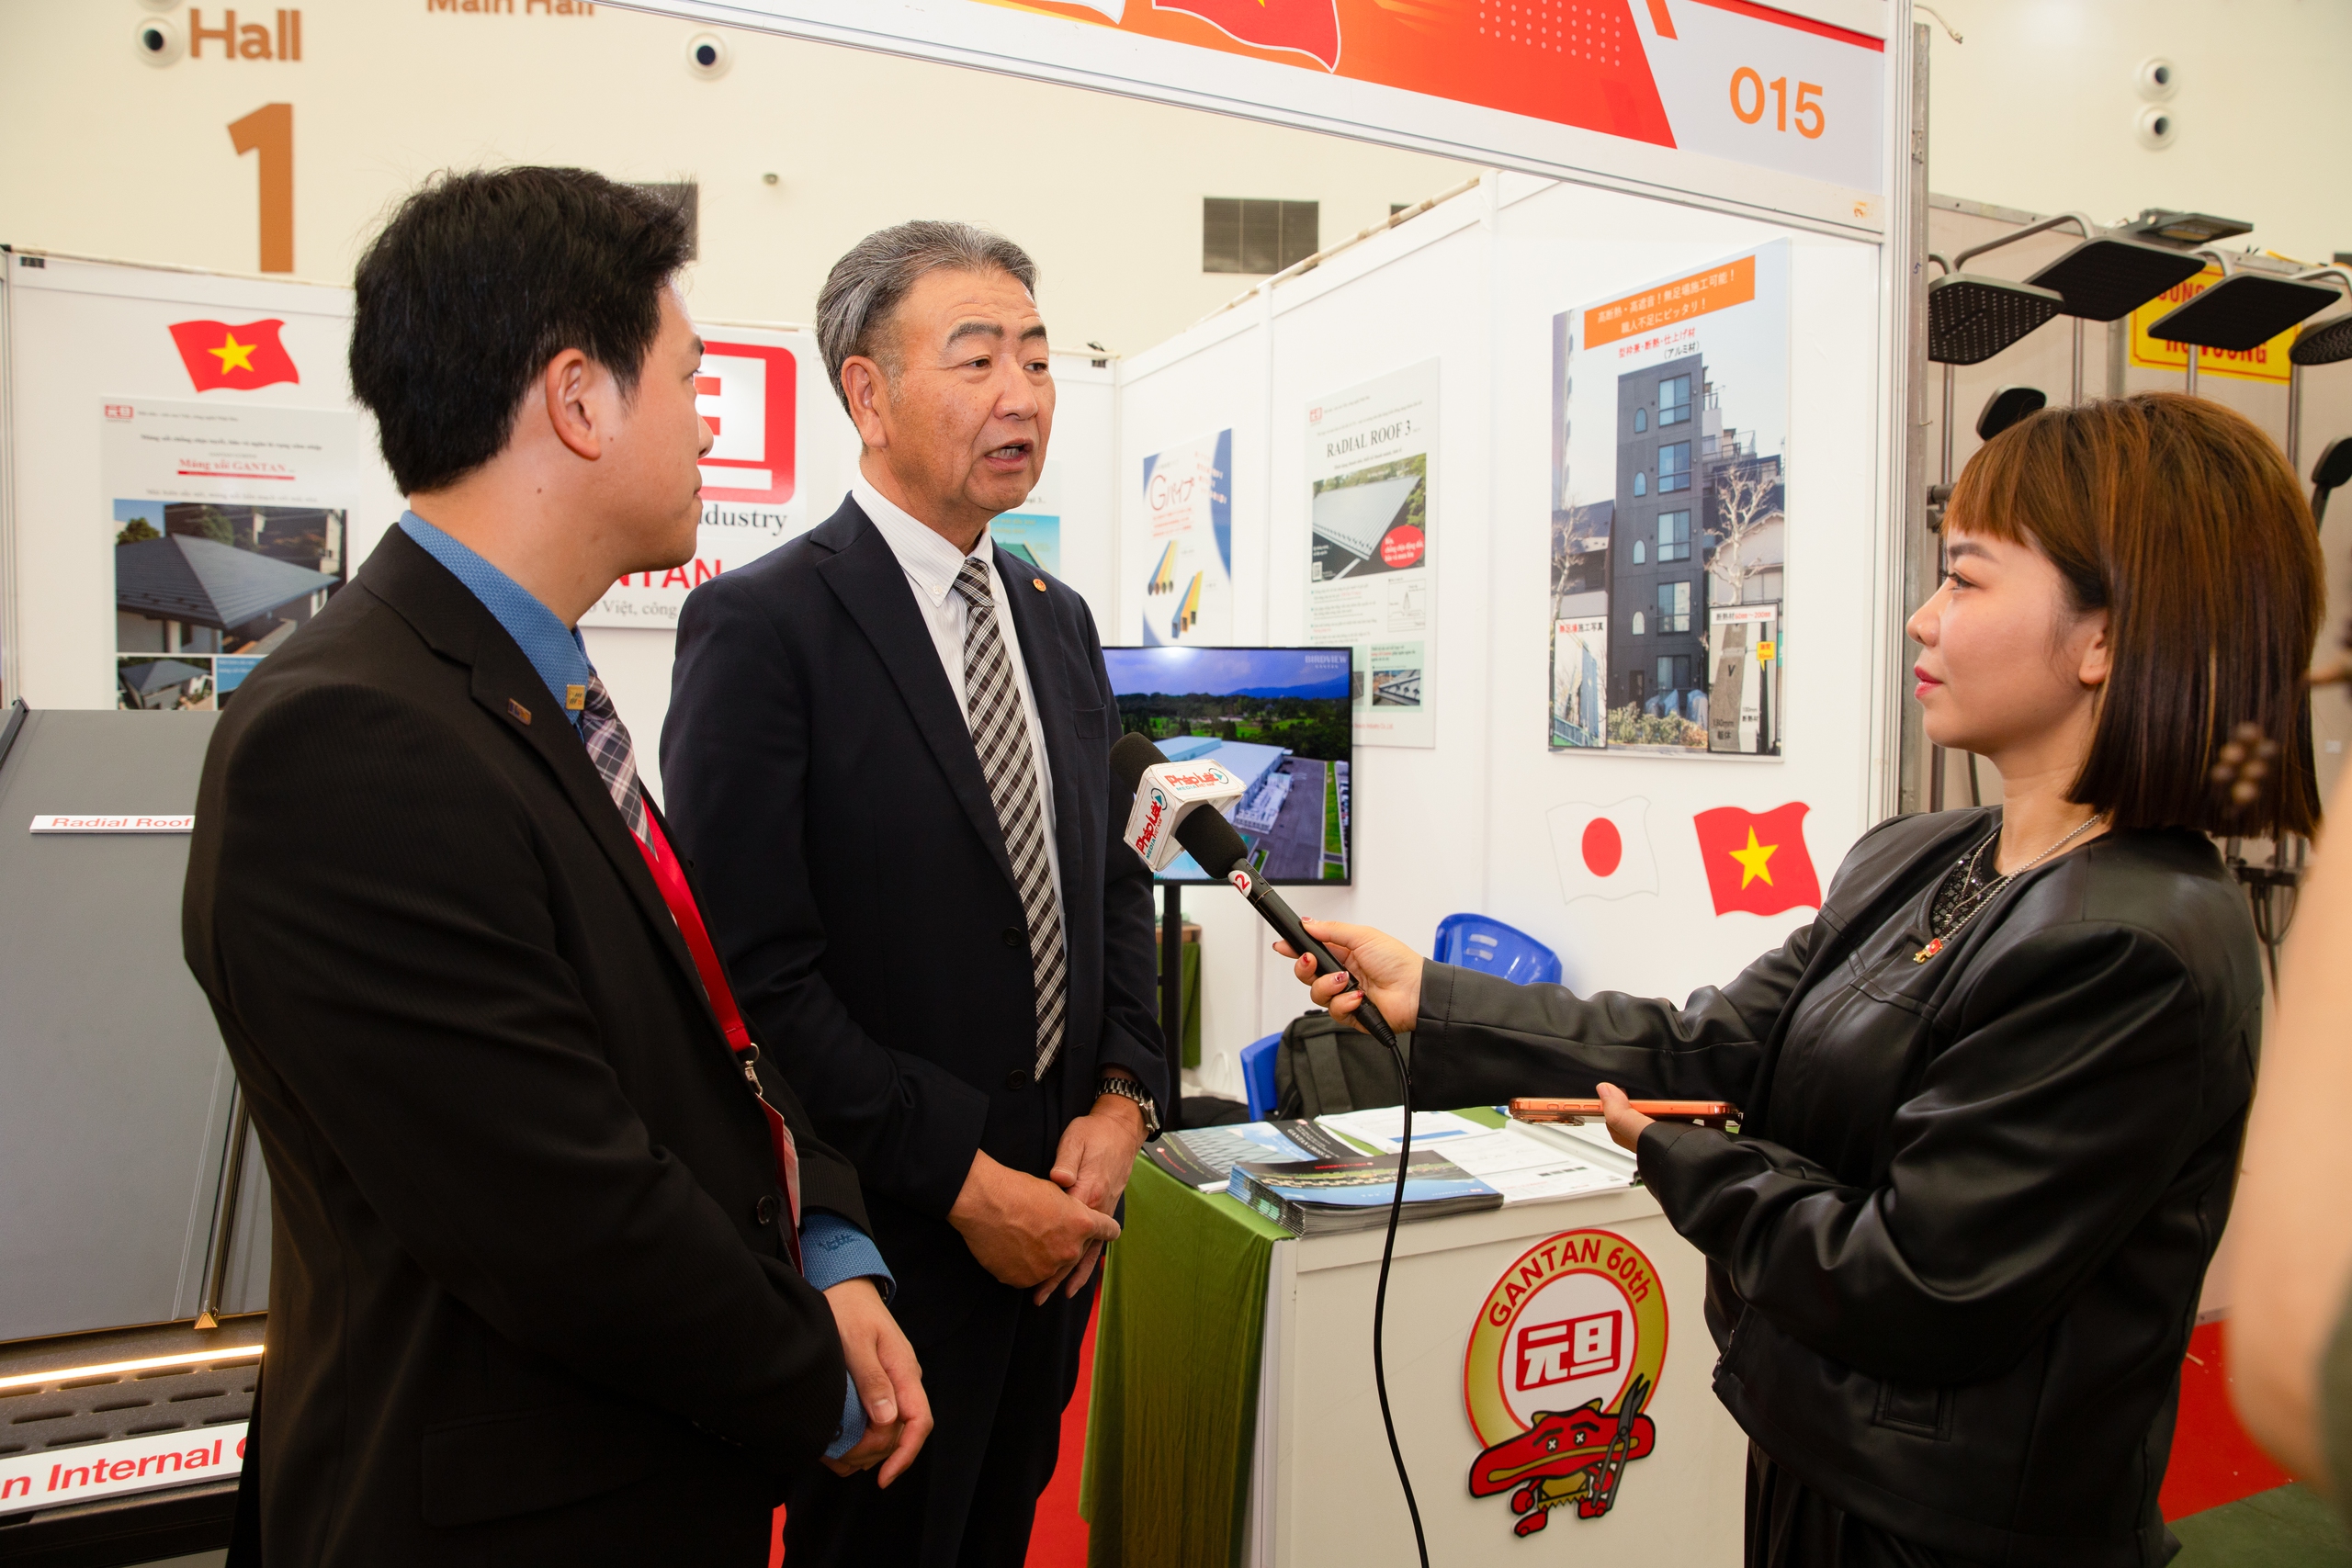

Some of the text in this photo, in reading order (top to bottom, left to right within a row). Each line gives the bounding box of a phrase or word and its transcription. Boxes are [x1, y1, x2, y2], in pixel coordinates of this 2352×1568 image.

[190, 9, 301, 61] Hall
[1730, 66, 1825, 140] 015
[227, 103, 294, 273] 1
[1327, 420, 1411, 457] RADIAL ROOF 3
[232, 461, 287, 472] GANTAN
[1305, 655, 1347, 664] BIRDVIEW
[51, 818, 193, 827] Radial Roof
[1146, 838, 1156, 860] MEDIA
[1488, 1238, 1650, 1327] GANTAN 60th
[47, 1439, 222, 1492] Internal
